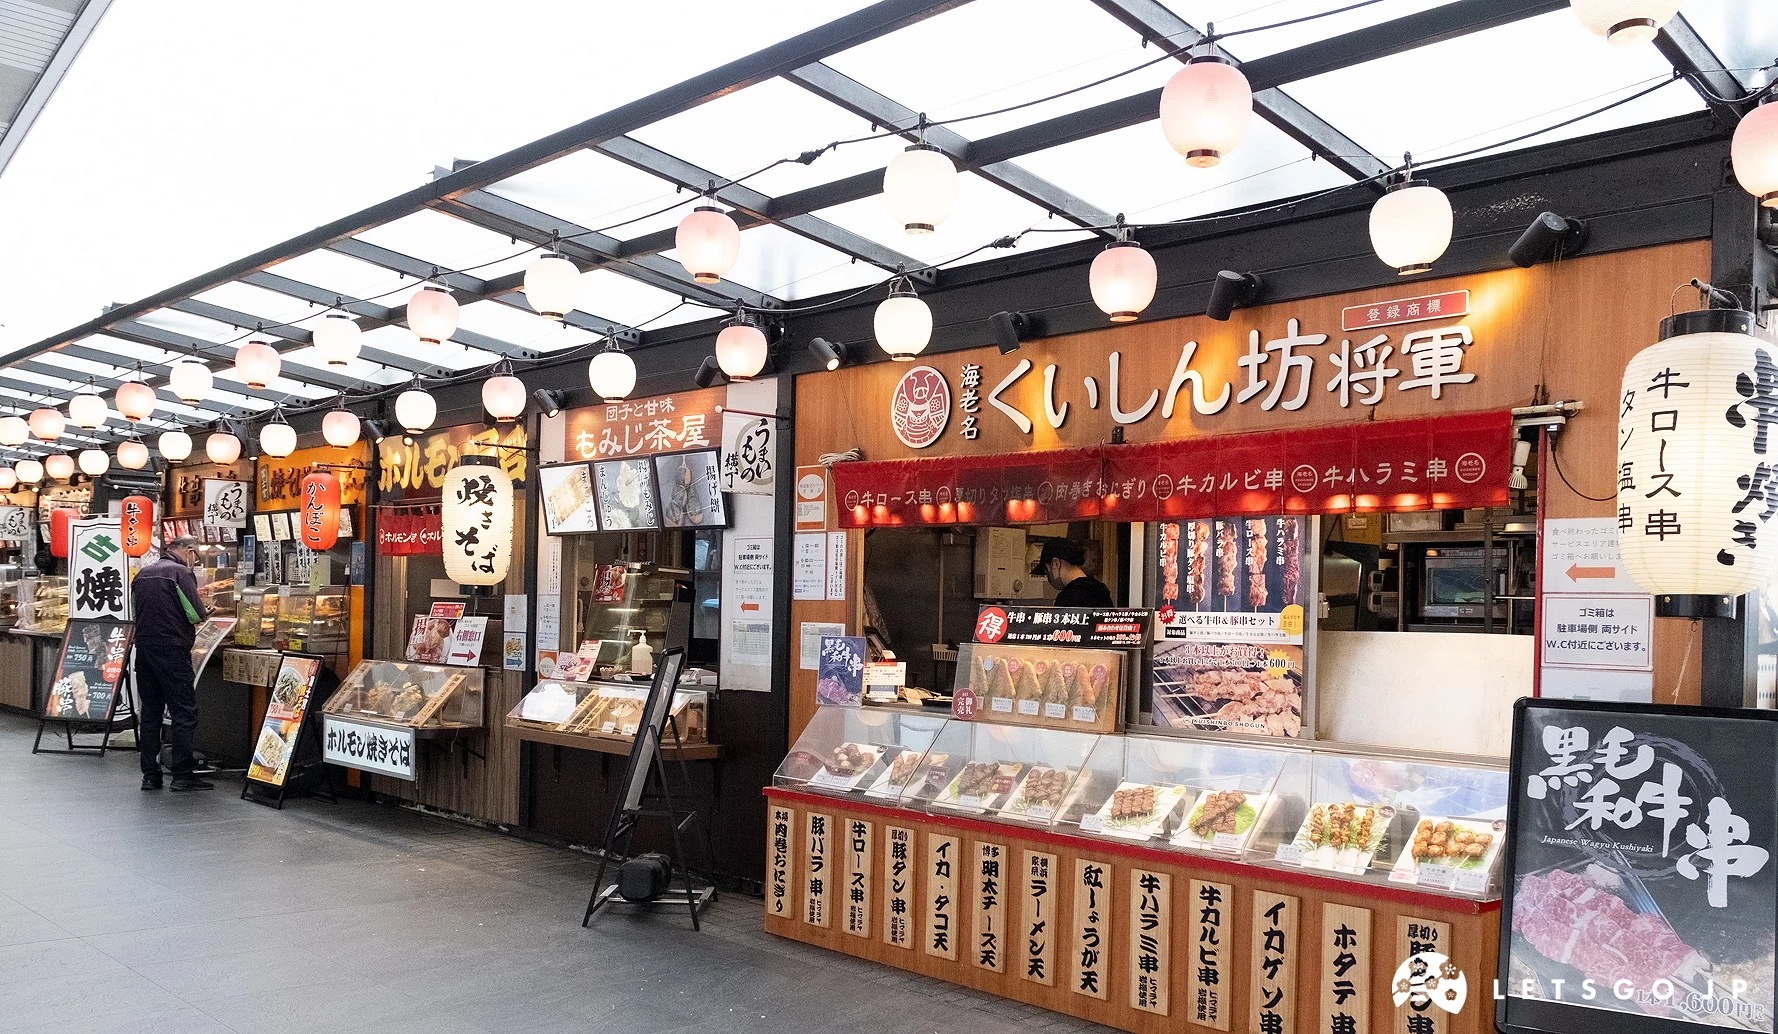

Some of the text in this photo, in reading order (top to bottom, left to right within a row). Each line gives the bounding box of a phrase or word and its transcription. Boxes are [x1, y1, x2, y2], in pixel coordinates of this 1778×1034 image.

[1366, 299, 1442, 323] 登録商標
[988, 317, 1477, 436] くいしん坊将軍
[606, 398, 676, 422] 団子と甘味
[959, 363, 979, 440] 海老名
[576, 414, 710, 459] もみじ茶屋
[1645, 367, 1690, 542] 牛ロース串
[1176, 467, 1283, 497] 牛カルビ串
[1322, 456, 1448, 489] 牛ハラミ串
[1617, 388, 1637, 535] タン塩串
[860, 487, 932, 509] 牛ロース串
[1055, 475, 1146, 501] 肉巻きおにぎり
[306, 482, 326, 542] かんぼこ
[455, 475, 498, 575] 焼きそば
[1552, 526, 1618, 536] 食べ終わったゴミ
[1159, 523, 1168, 568] 牛カルビ串
[1215, 521, 1225, 558] 豚バラ串
[1245, 519, 1255, 567] 牛ロース串
[1275, 518, 1286, 567] 牛ハラミ串
[979, 611, 1005, 640] 得
[1557, 623, 1638, 635] 駐車場側 両サイド
[1579, 608, 1615, 618] ゴミ箱は
[107, 626, 126, 664] 牛串
[1546, 640, 1647, 652] W.C付近にございます。
[327, 726, 412, 768] ホルモン焼きそば
[810, 815, 825, 897] 豚バラ串
[850, 820, 867, 903] 牛ロース串
[982, 844, 999, 857] 博多
[1541, 834, 1655, 853] Japanese Wagyu Kushiyaki
[1676, 796, 1770, 908] 串
[890, 842, 907, 915] 豚タン串
[932, 841, 951, 951] イカ・タコ天
[979, 859, 998, 968] 明太チーズ天
[1027, 879, 1047, 979] ラーメン天
[1079, 864, 1104, 994] 紅しょうが天
[1138, 873, 1161, 974] 牛ハラミ串
[1197, 885, 1222, 987] 牛カルビ串
[1407, 923, 1438, 941] 厚切り
[1259, 901, 1287, 1034] イカゲソ串
[1330, 923, 1357, 1034] ホタテ串
[1149, 977, 1158, 1008] ヒマラヤ
